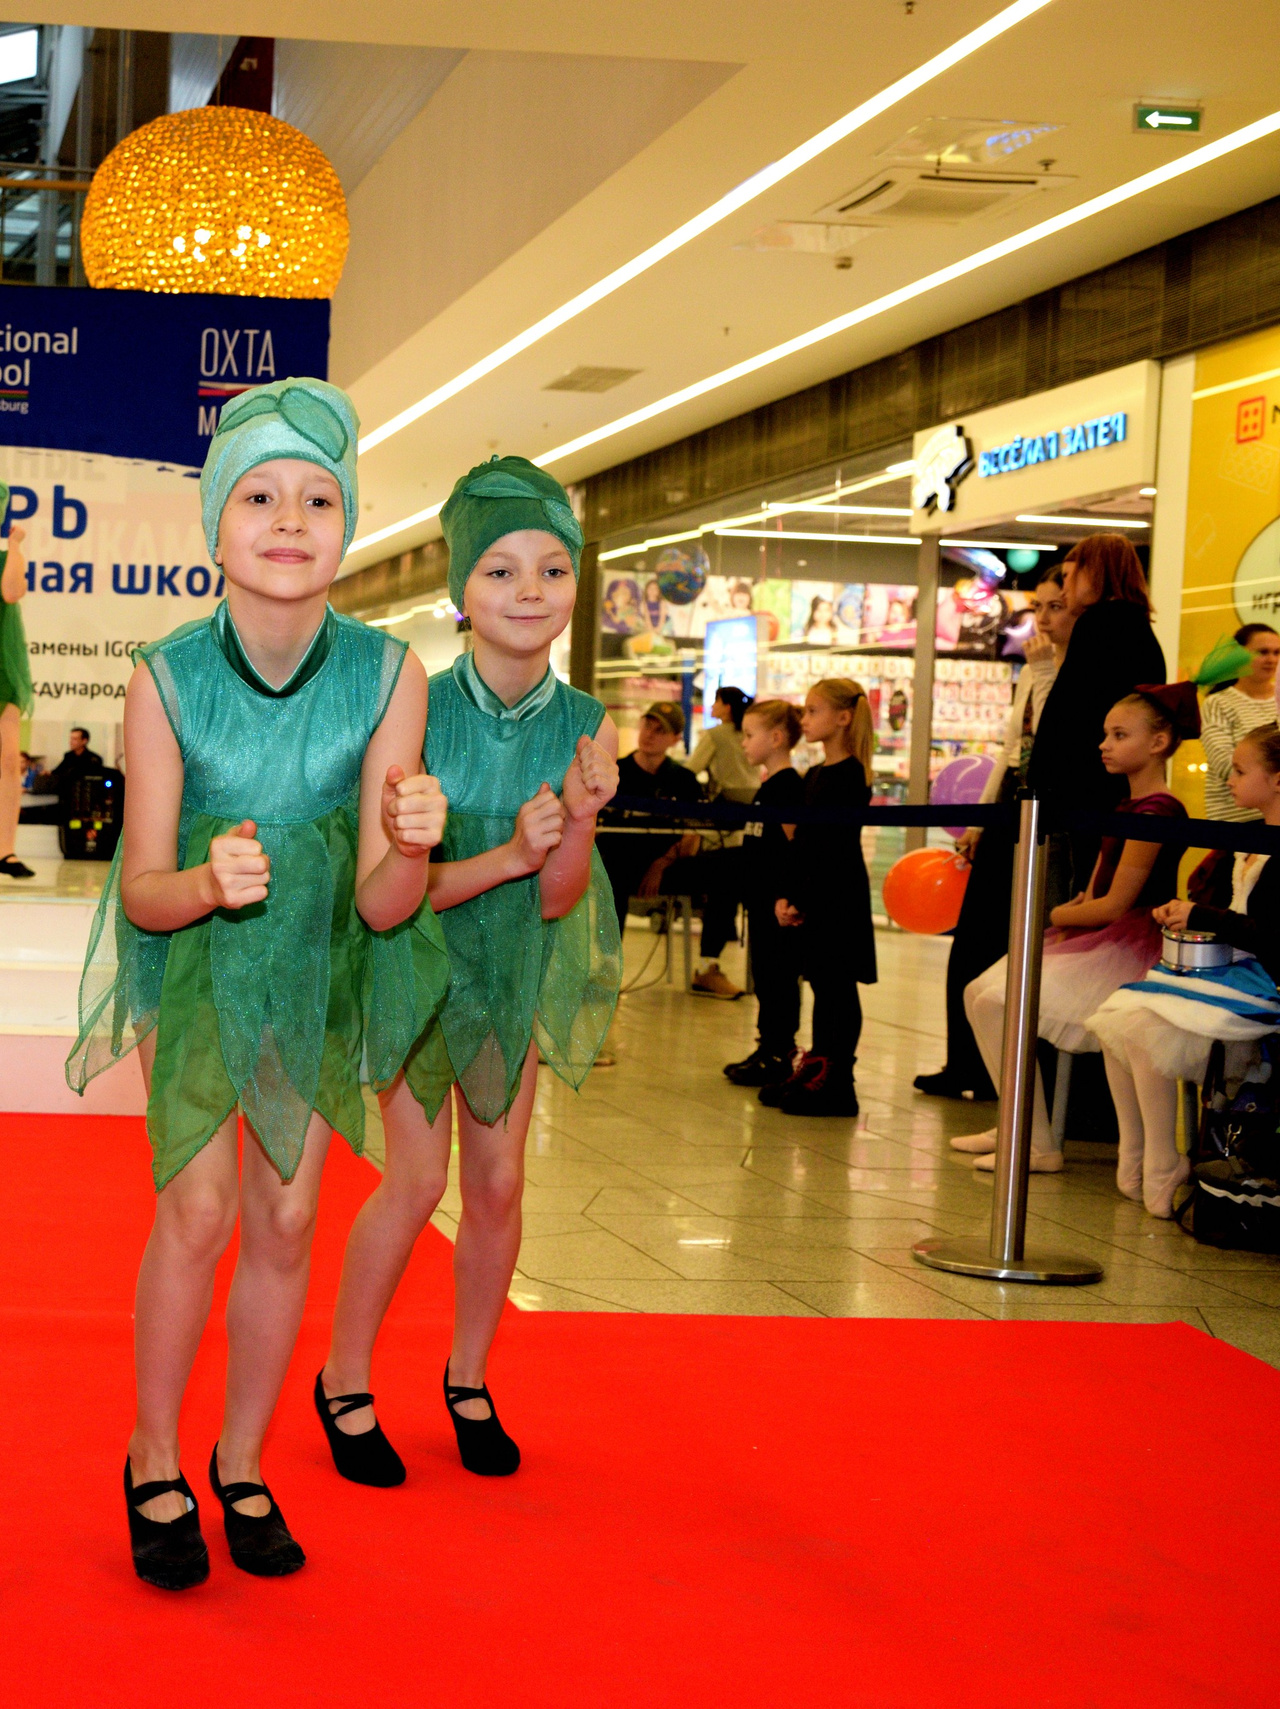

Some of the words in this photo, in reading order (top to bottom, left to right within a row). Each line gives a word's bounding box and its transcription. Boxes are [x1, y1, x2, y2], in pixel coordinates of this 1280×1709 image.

[200, 327, 276, 377] ОХТА
[1061, 411, 1127, 457] ЗАТЕЯ
[29, 640, 98, 656] амены
